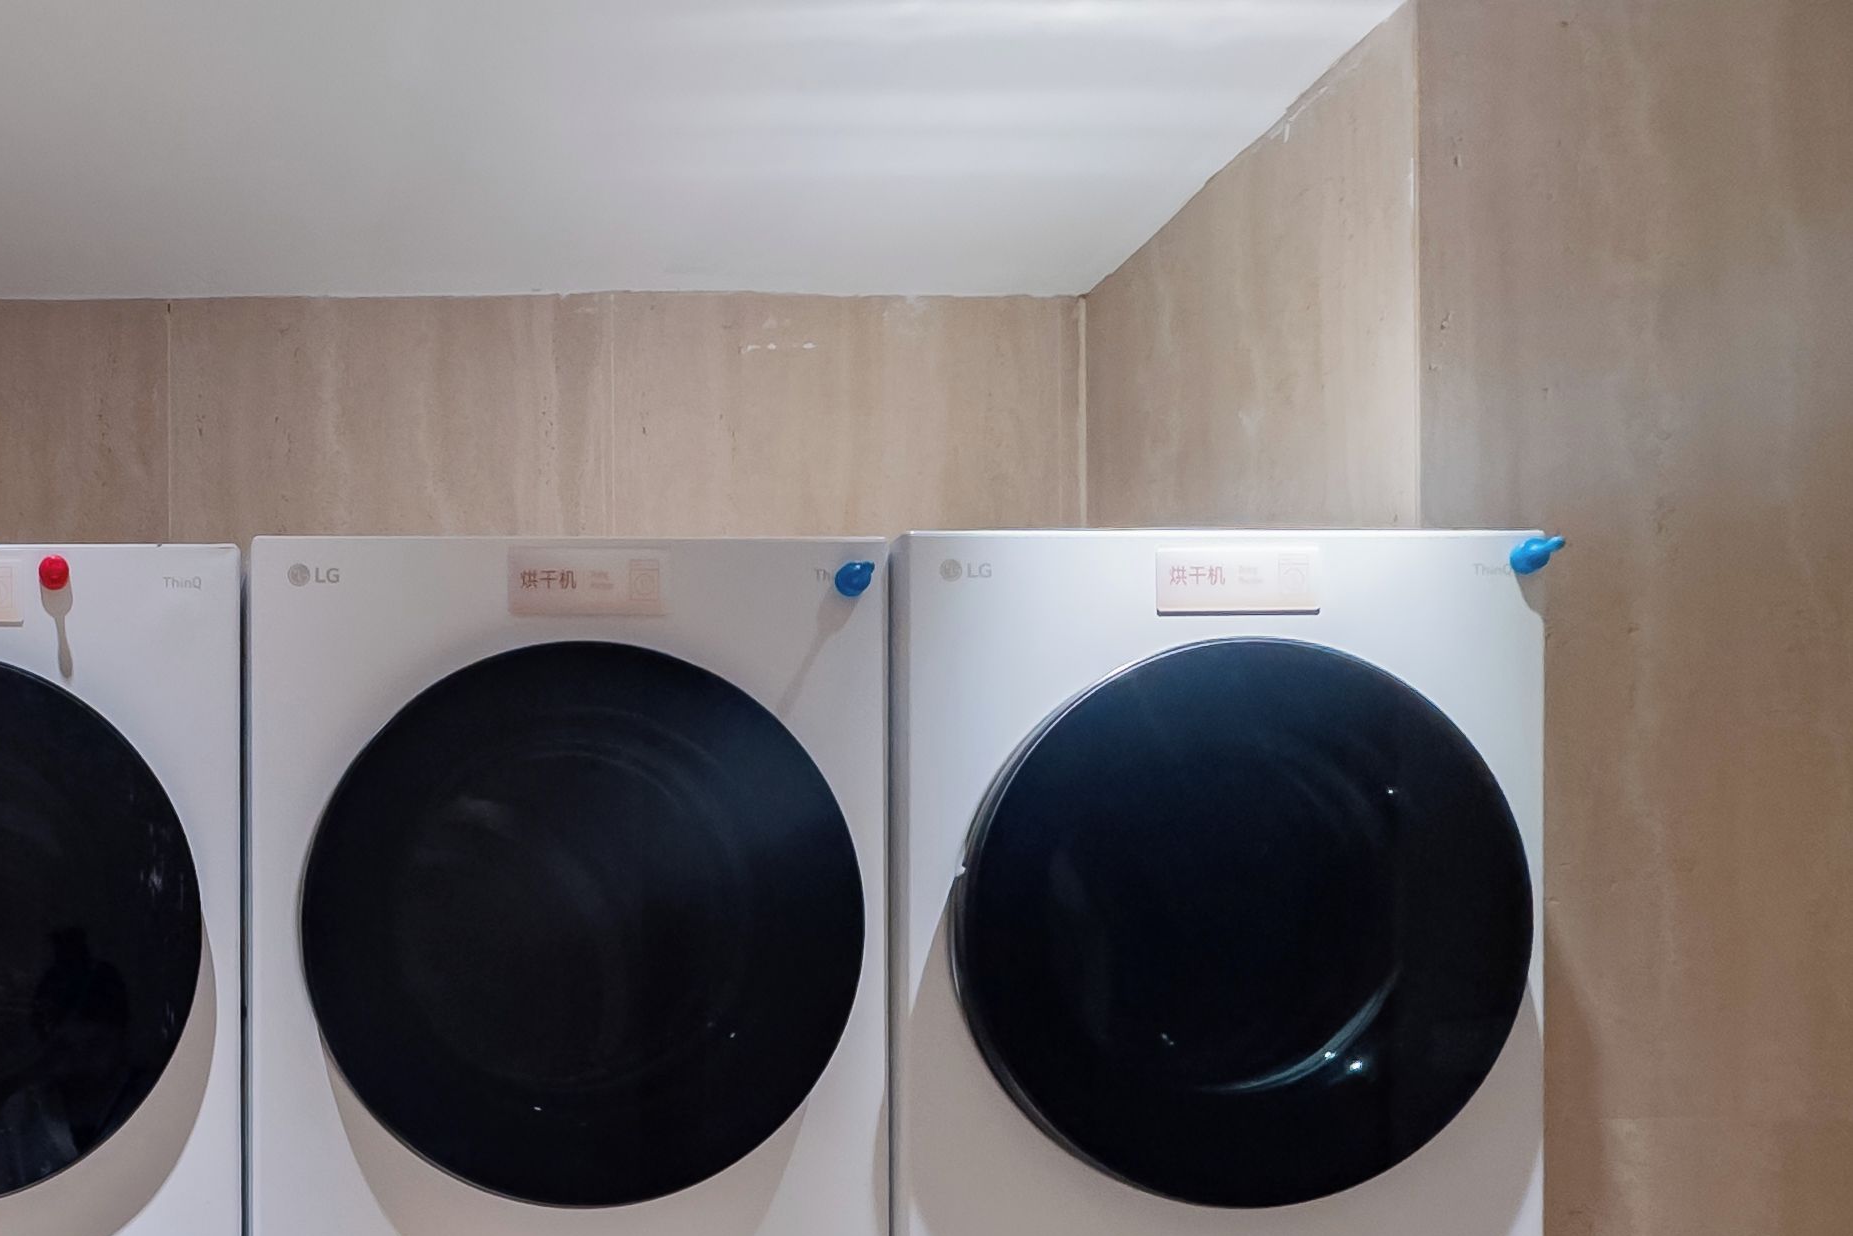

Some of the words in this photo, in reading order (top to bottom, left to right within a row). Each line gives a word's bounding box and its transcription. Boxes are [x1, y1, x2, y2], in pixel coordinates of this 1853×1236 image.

[314, 567, 340, 584] LG
[519, 568, 577, 590] 烘干机
[966, 562, 993, 579] LG
[1168, 565, 1226, 586] 烘干机
[162, 575, 203, 590] ThinQ
